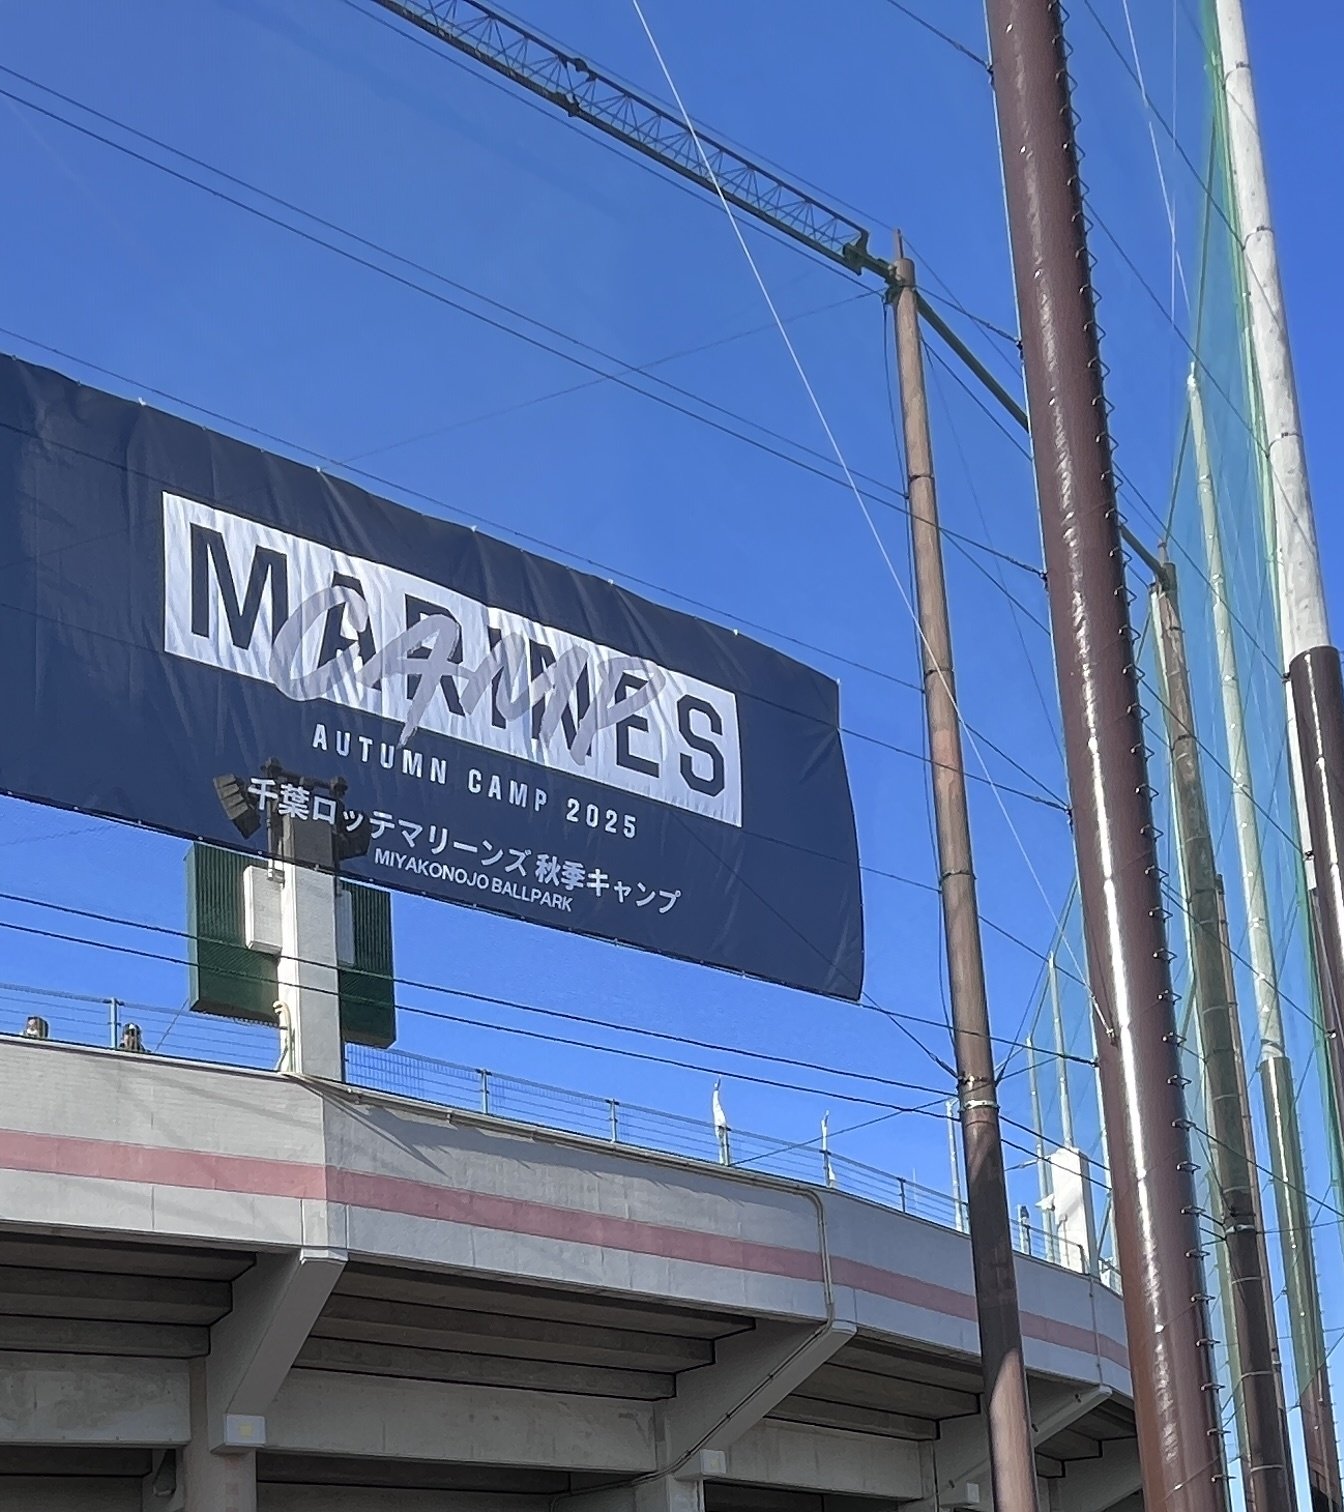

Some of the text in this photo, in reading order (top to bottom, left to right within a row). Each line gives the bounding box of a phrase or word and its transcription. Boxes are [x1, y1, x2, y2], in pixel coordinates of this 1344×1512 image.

[190, 522, 725, 797] MARINES
[312, 723, 637, 839] AUTUMN CAMP 2025
[247, 777, 682, 914] 千葉ロッテマリーンズ 秋季キャンプ
[374, 847, 574, 913] MIYAKONOJO BALLPARK
